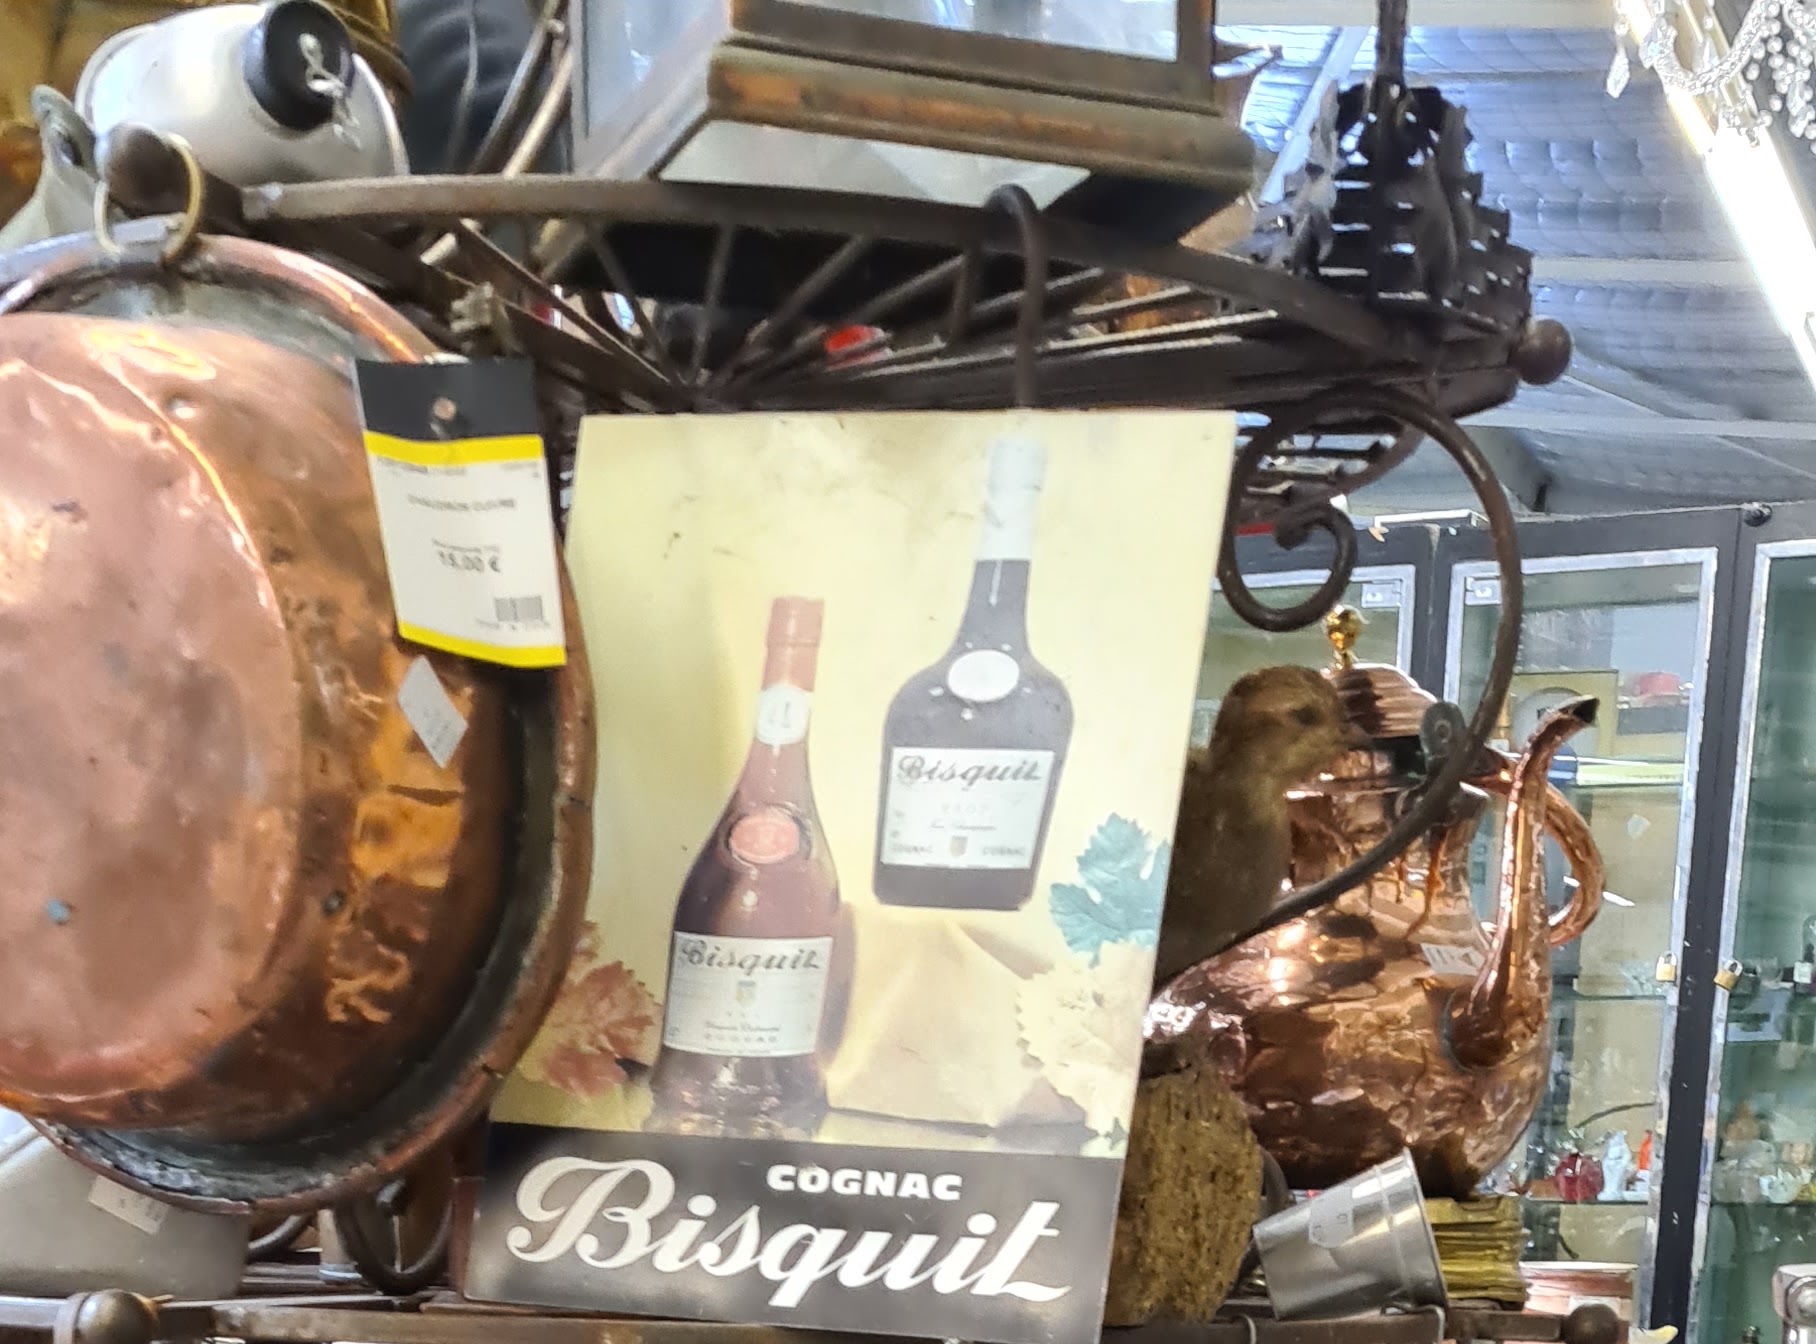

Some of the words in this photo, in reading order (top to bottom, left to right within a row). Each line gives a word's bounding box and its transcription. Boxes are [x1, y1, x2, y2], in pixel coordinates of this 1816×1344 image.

[897, 755, 1042, 791] Bisquit
[680, 938, 821, 976] Bisquit
[766, 1164, 963, 1200] COGNAC
[505, 1156, 1073, 1308] Bisquit
